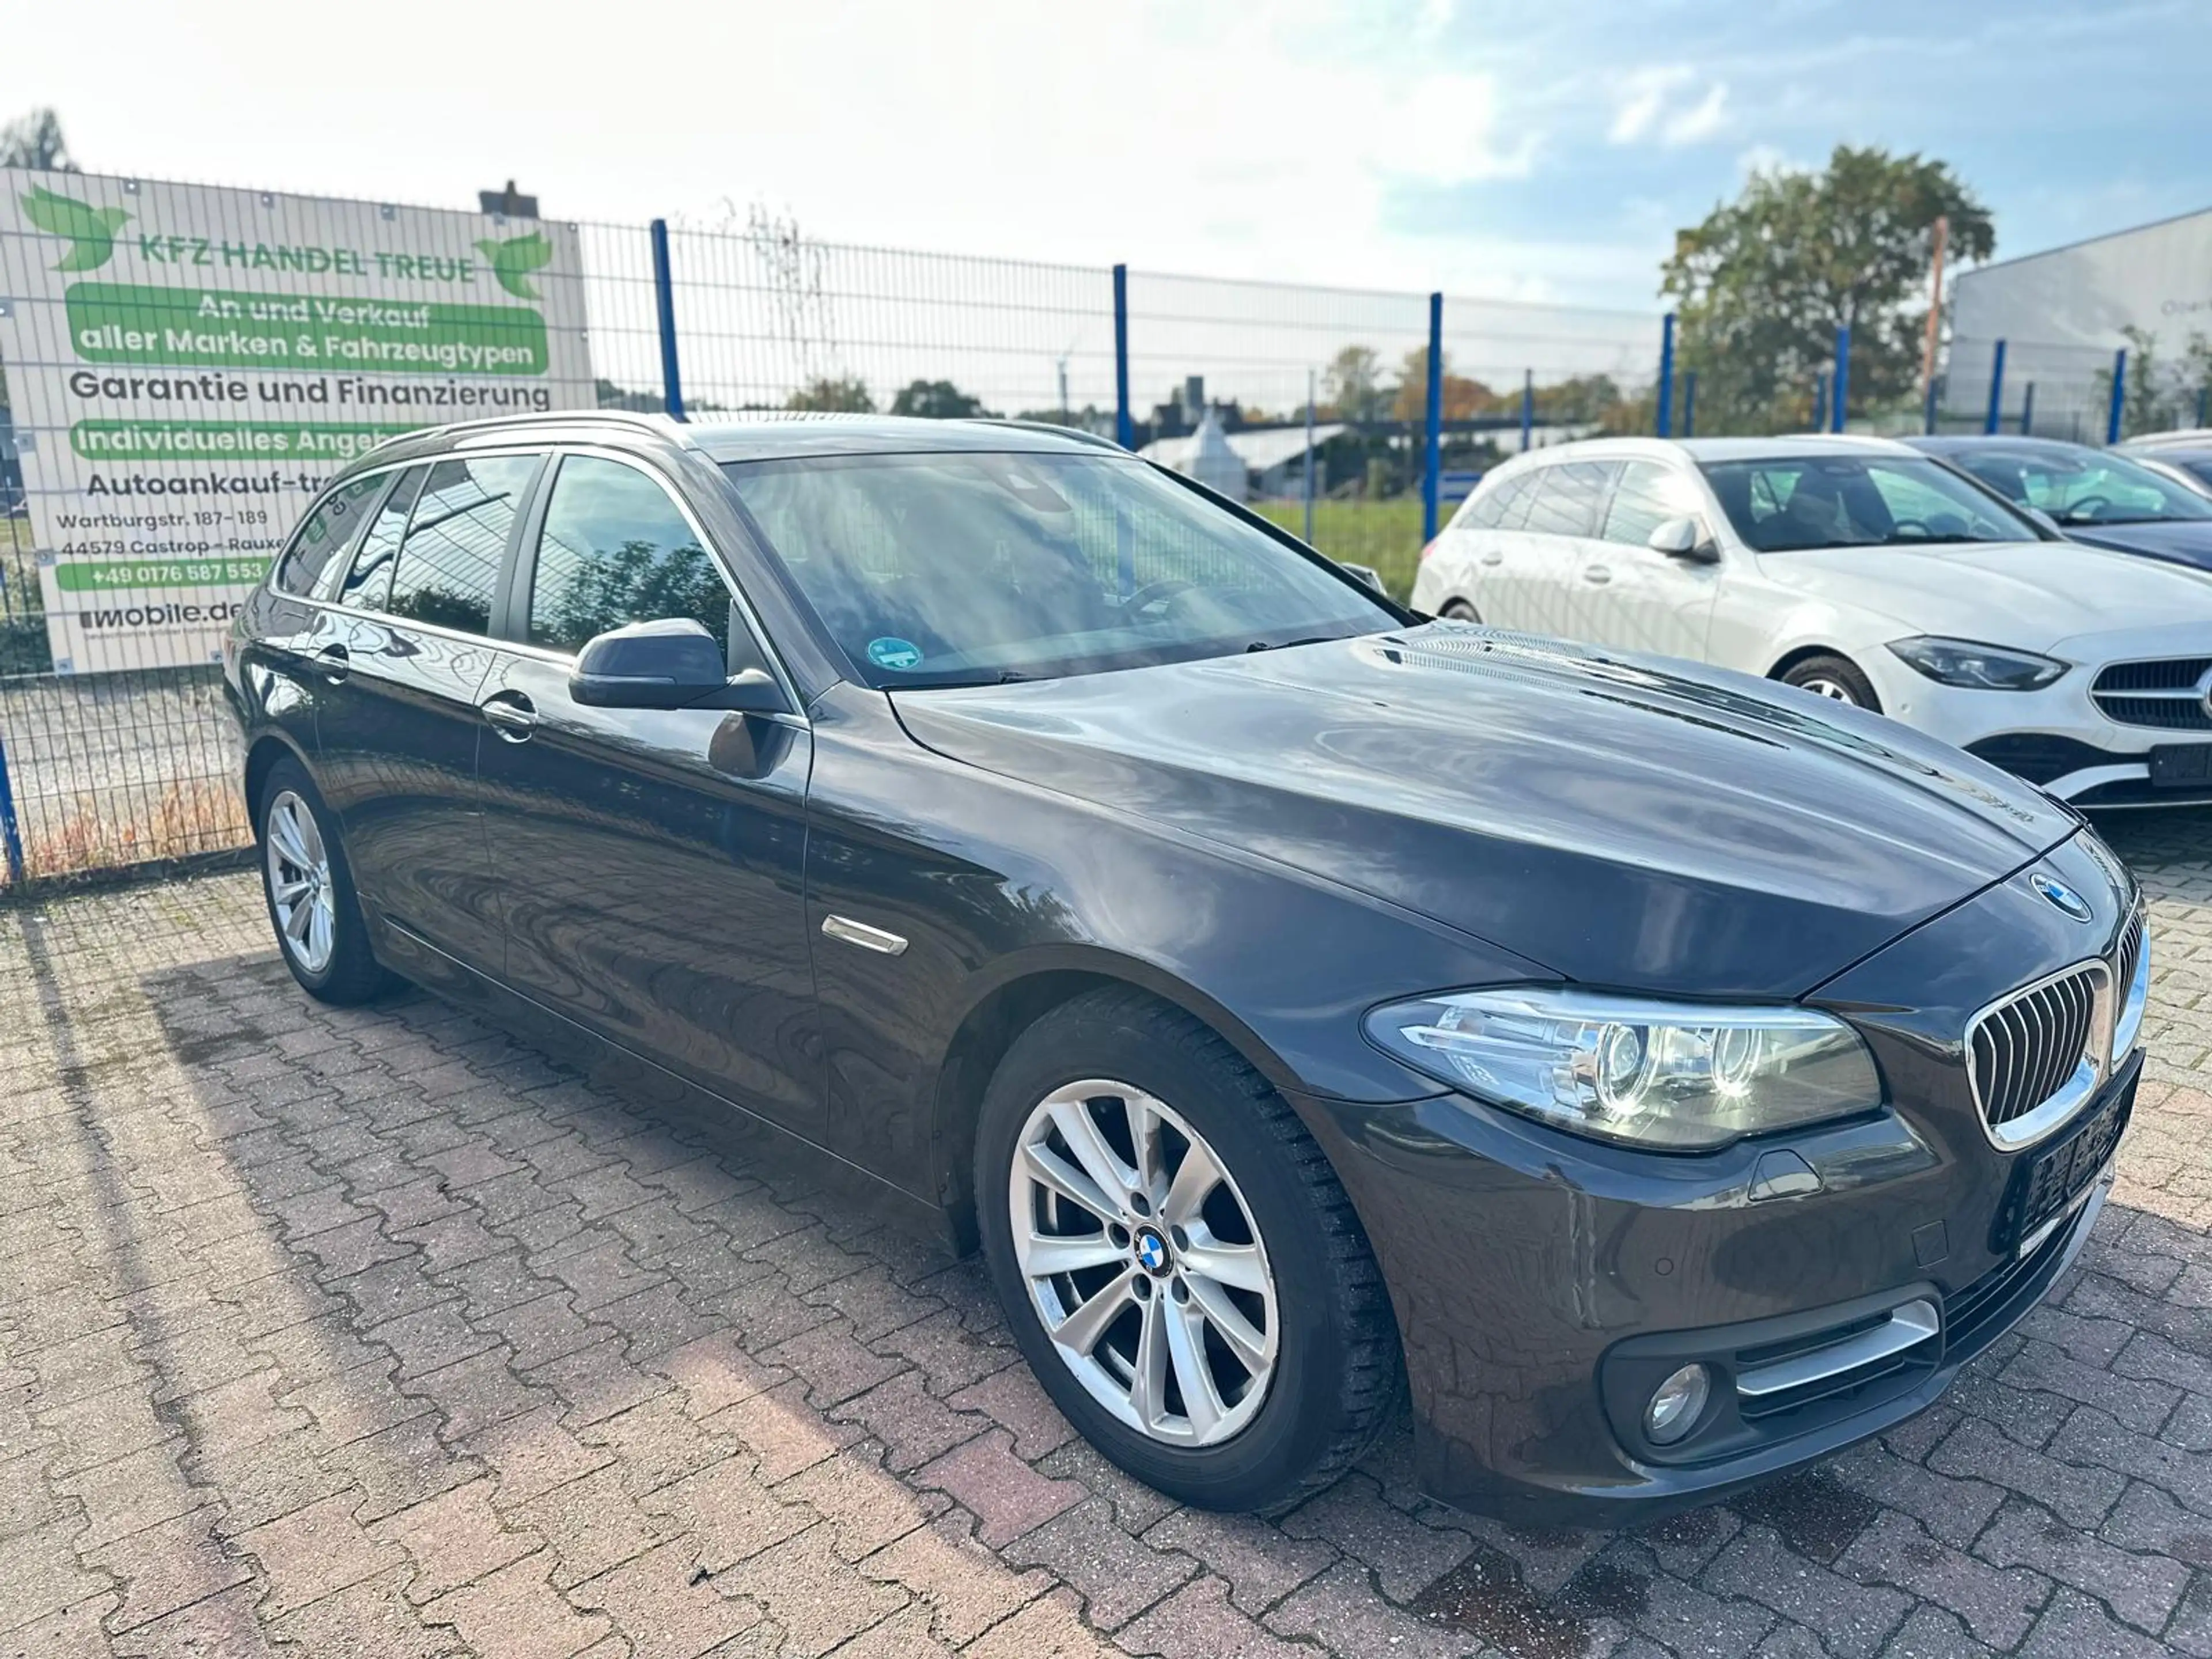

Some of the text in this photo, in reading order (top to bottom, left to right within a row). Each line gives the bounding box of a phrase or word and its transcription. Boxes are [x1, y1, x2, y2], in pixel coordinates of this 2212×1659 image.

[139, 233, 475, 283] KFZ HANDEL TREUE
[198, 294, 430, 328] An und Verkauf
[79, 324, 533, 370] aller Marken & Fahrzeugtypen
[70, 371, 550, 411] Garantie und Finanzierung
[77, 425, 289, 450] Individuelles
[56, 513, 190, 531] Wartburgstr.
[239, 510, 268, 525] 189
[62, 540, 125, 555] 44579
[130, 539, 210, 556] Castrop
[92, 567, 131, 585] +49
[137, 566, 181, 583] 0176
